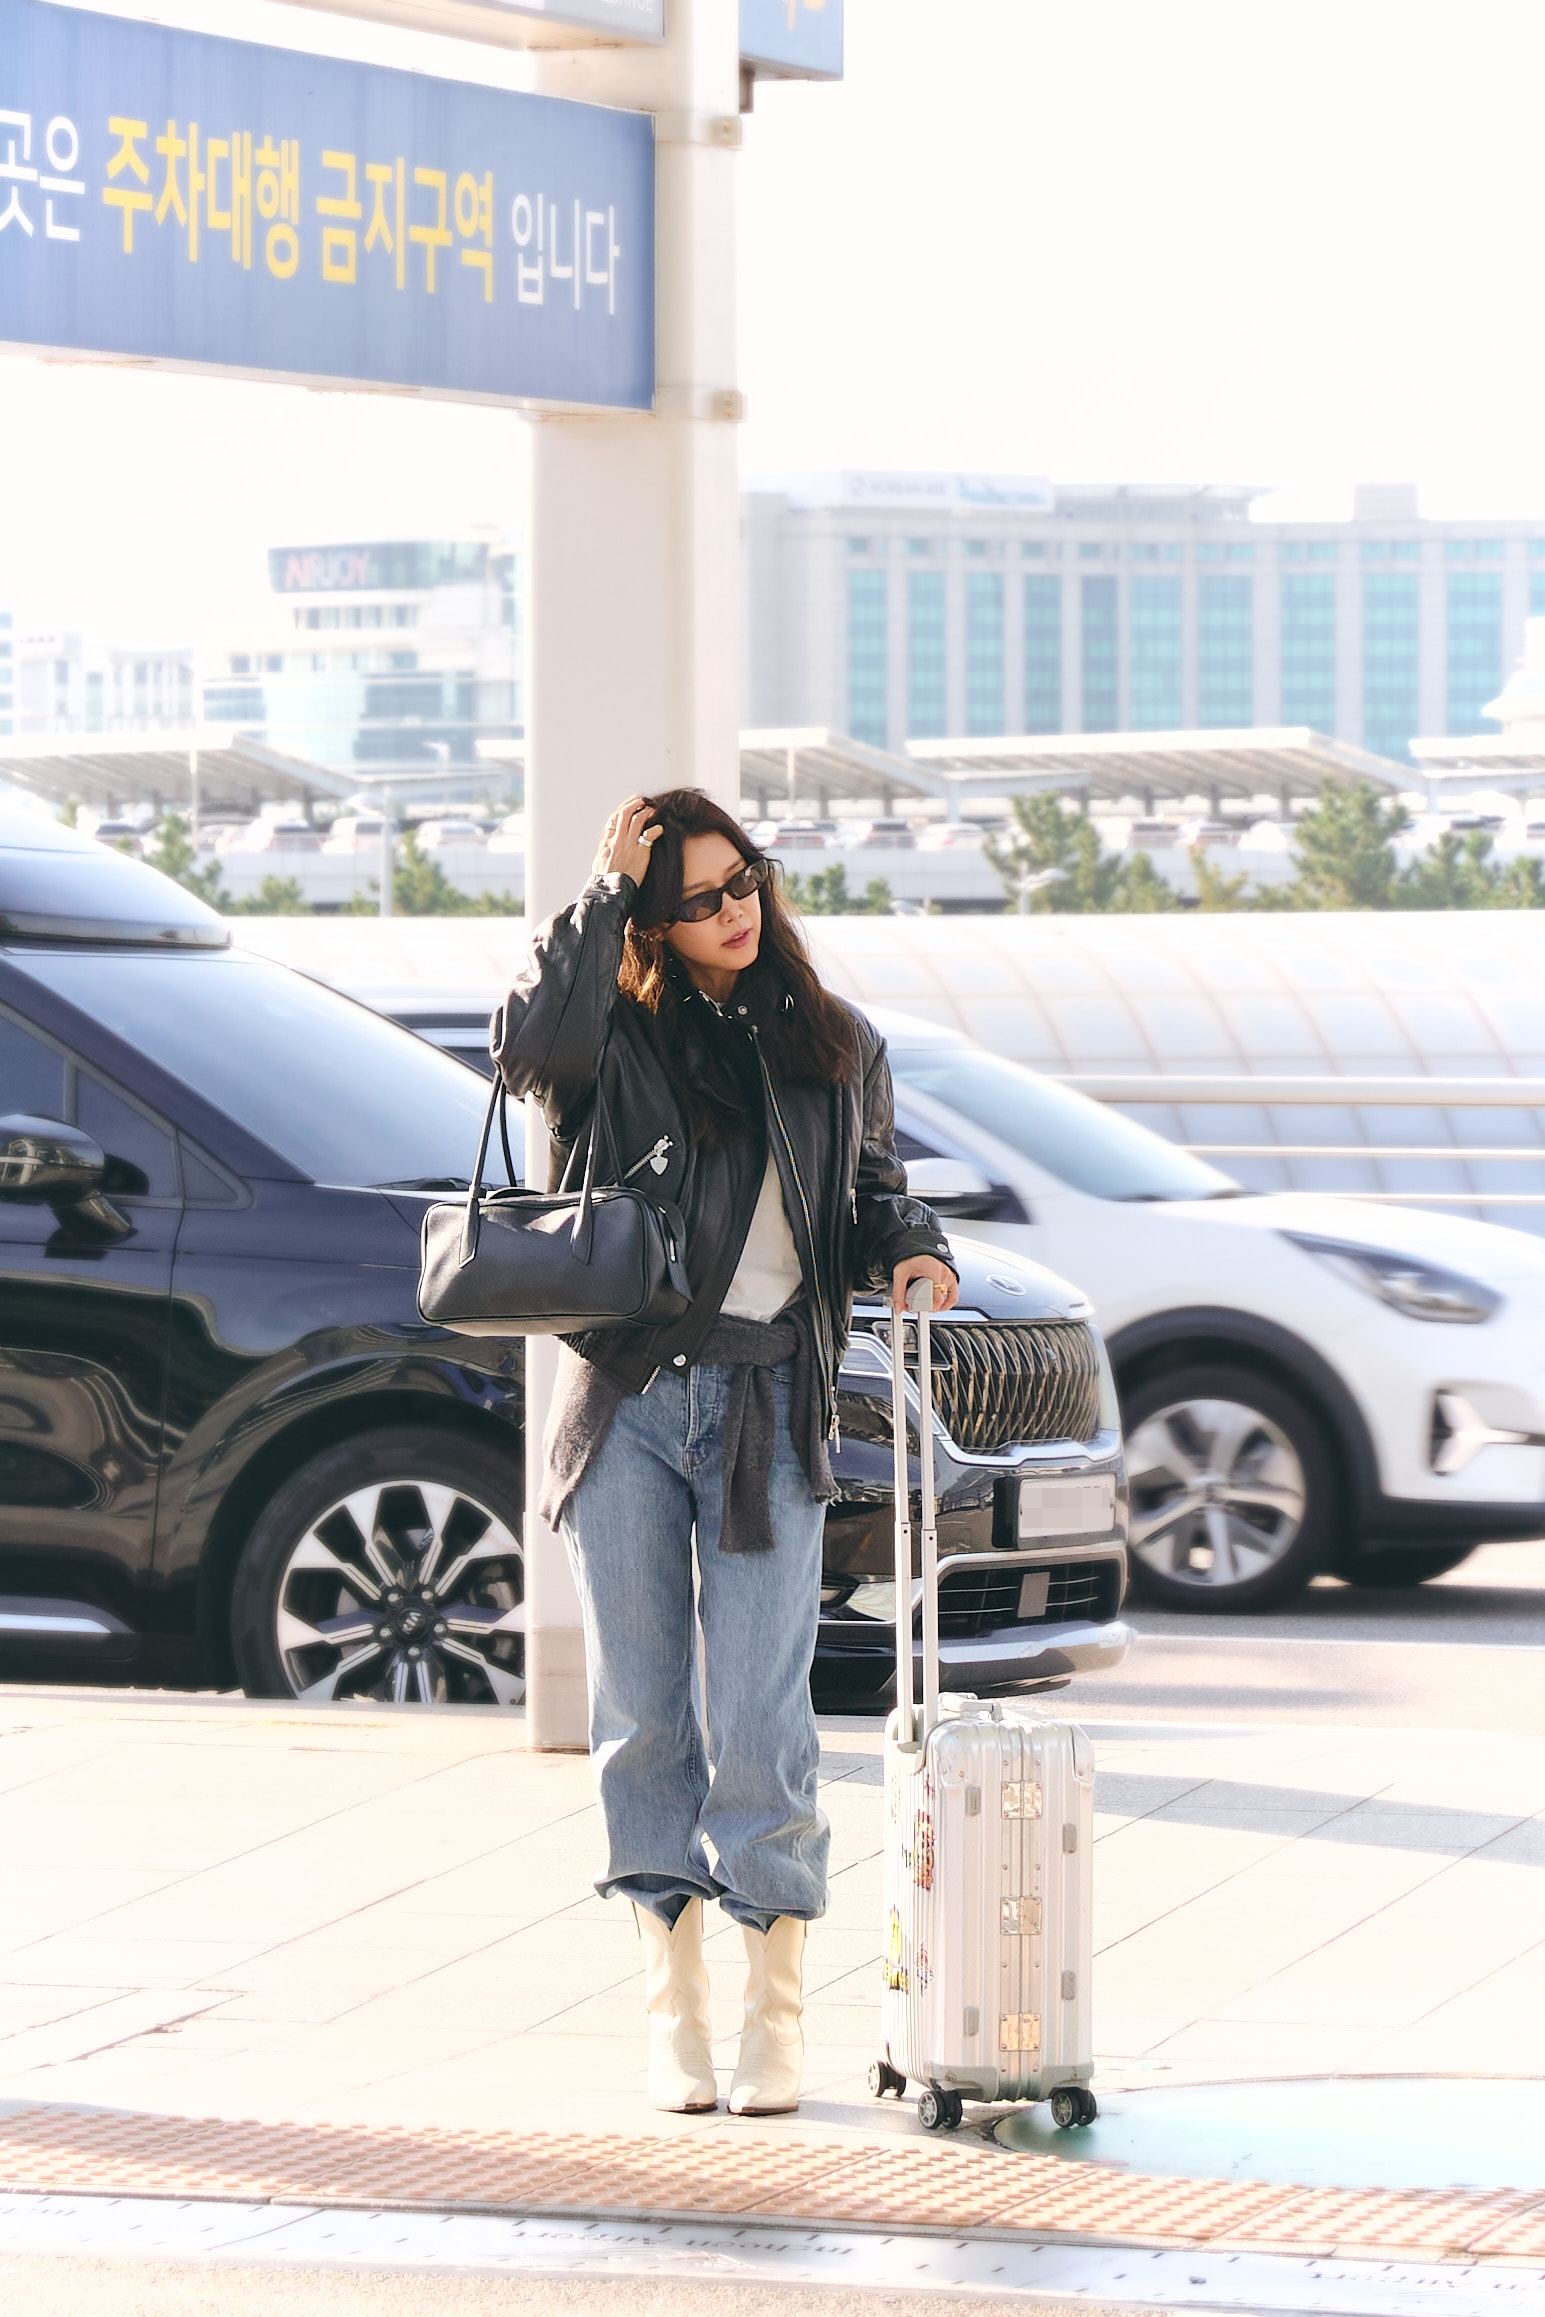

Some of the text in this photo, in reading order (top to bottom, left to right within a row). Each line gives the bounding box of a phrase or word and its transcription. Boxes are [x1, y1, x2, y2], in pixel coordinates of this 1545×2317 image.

[0, 109, 621, 316] 곳은 주차대행 금지구역 입니다
